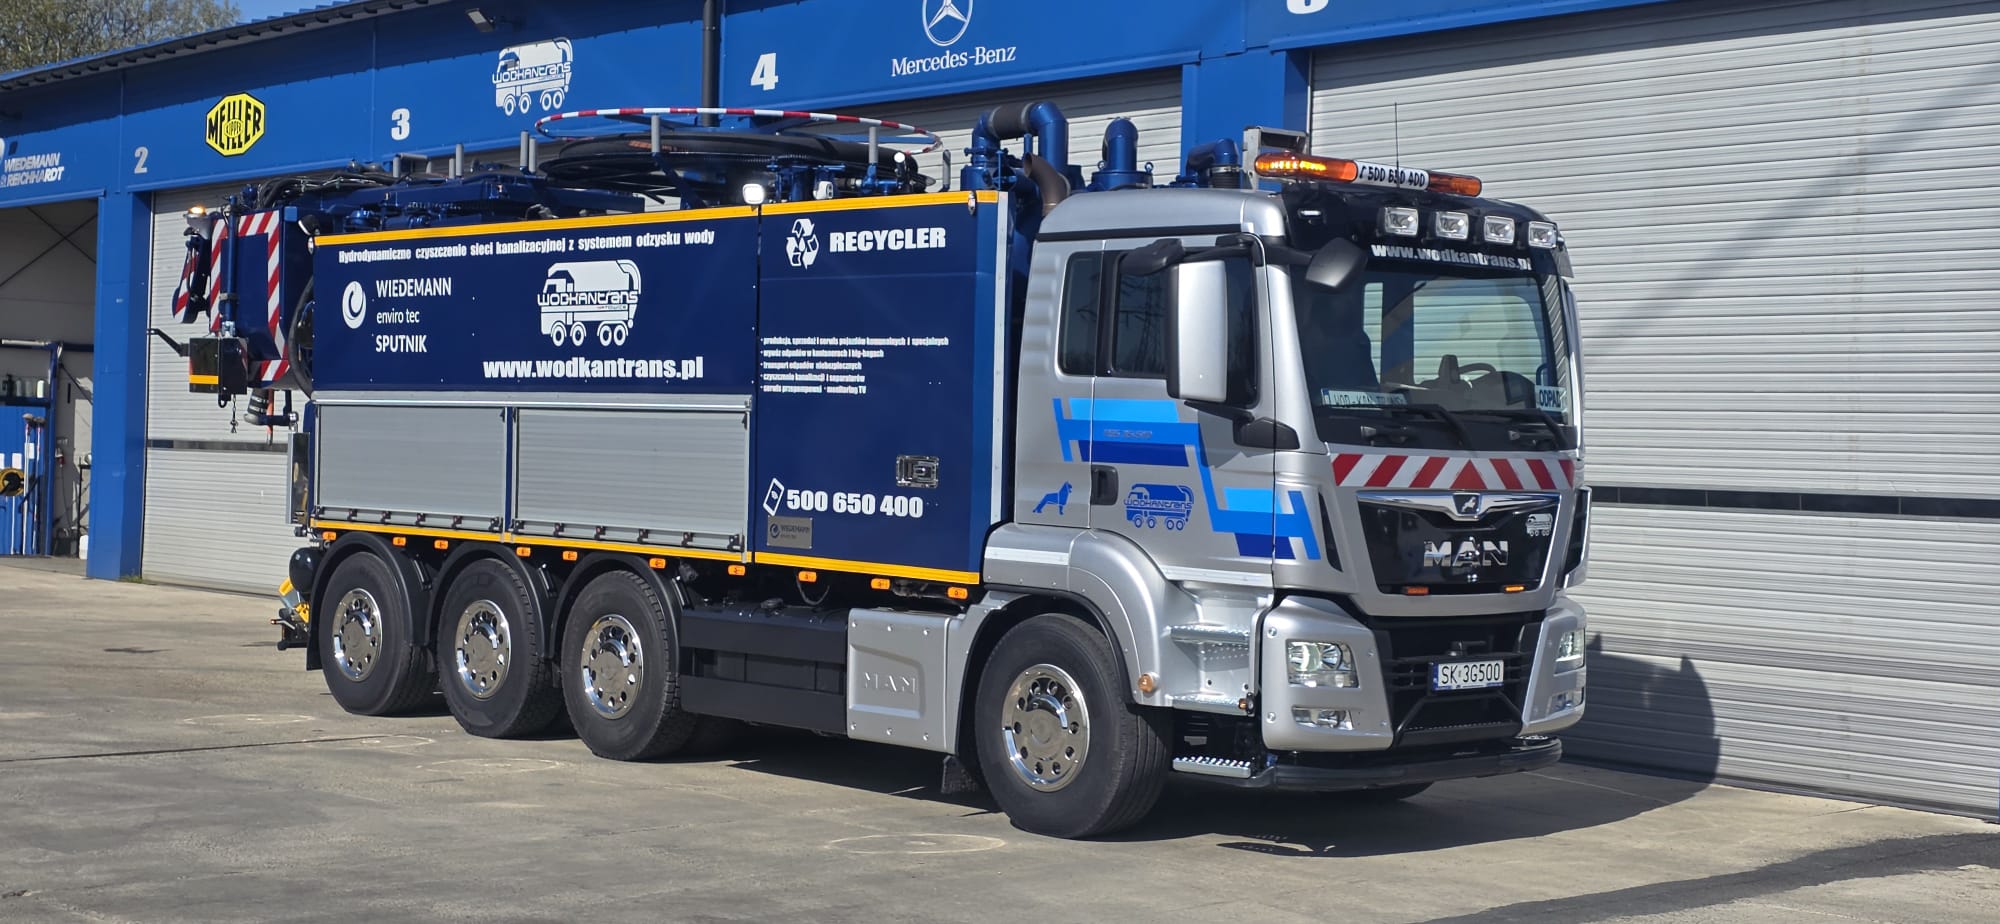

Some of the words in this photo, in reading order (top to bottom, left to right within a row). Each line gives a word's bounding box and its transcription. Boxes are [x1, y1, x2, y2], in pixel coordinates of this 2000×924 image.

[751, 52, 779, 91] 4
[891, 46, 1017, 77] Mercedes-Benz
[208, 100, 261, 150] MEILLER
[391, 108, 410, 141] 3
[4, 152, 61, 173] WIEDEMANN
[134, 146, 149, 174] 2
[6, 166, 65, 187] REICHHARDT
[1367, 166, 1386, 182] 500
[1408, 171, 1426, 187] 400
[338, 248, 412, 264] Hydrodynamiczne
[415, 243, 468, 260] czyszczenie
[470, 242, 494, 257] sieci
[495, 237, 566, 255] kanalizacyjnej
[568, 239, 575, 251] z
[577, 235, 632, 251] systemem
[636, 231, 681, 247] odzysku
[684, 229, 715, 245] wody
[829, 227, 946, 253] RECYCLER
[1371, 244, 1532, 270] www.wodkantrans.pl
[376, 276, 452, 299] WIEDEMANN
[376, 309, 402, 324] enviro
[405, 308, 420, 324] tec
[375, 334, 428, 353] SPUTNIK
[483, 356, 703, 380] www.wodkantrans.pl
[786, 489, 828, 512] 500
[832, 492, 876, 516] 650
[879, 496, 924, 518] 400
[1423, 540, 1509, 567] MAN
[863, 671, 917, 694] MAN
[1441, 665, 1458, 685] SK
[1463, 663, 1500, 683] 3G500
